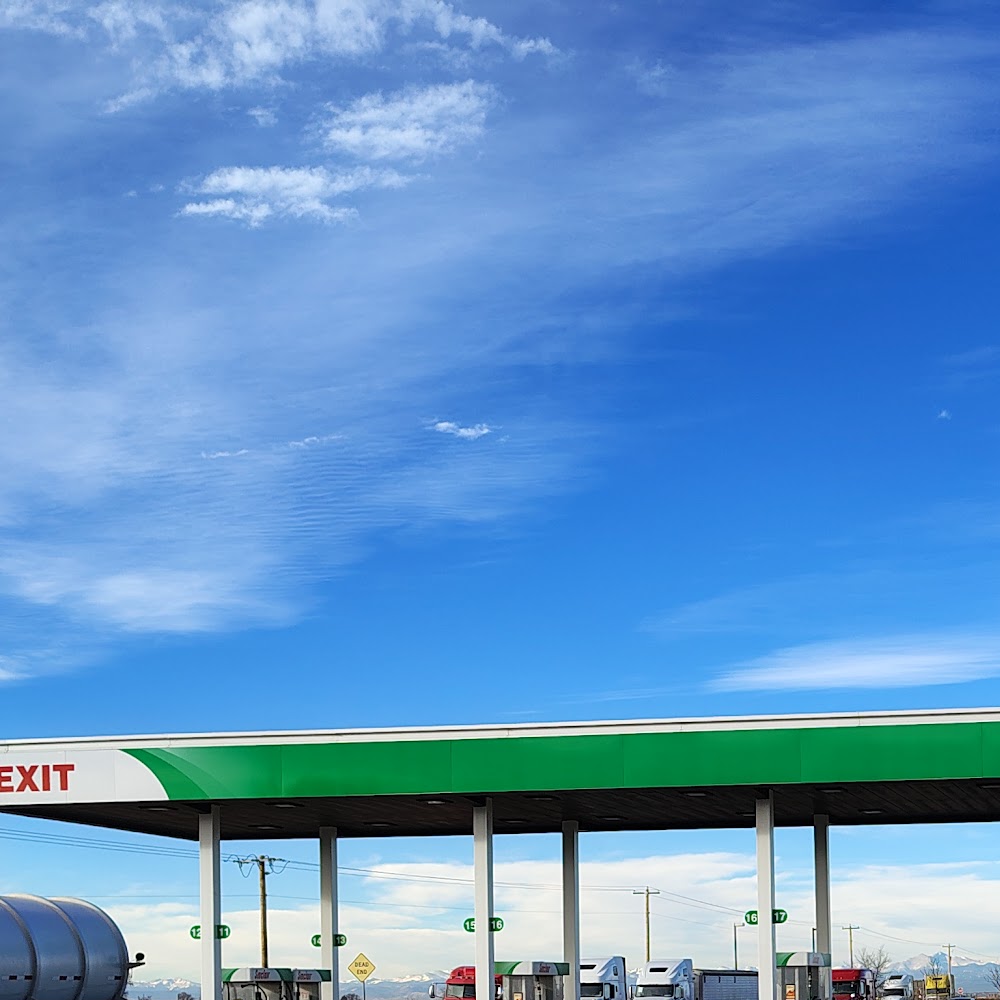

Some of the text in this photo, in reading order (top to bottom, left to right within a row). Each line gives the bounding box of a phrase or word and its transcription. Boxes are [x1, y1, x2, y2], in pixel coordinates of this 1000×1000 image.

[0, 764, 75, 792] EXIT
[746, 913, 758, 922] 16
[774, 911, 786, 921] 17
[465, 920, 475, 930] 15
[491, 920, 503, 930] 16
[191, 927, 201, 937] 12
[219, 927, 229, 936] 11
[336, 935, 346, 944] 13
